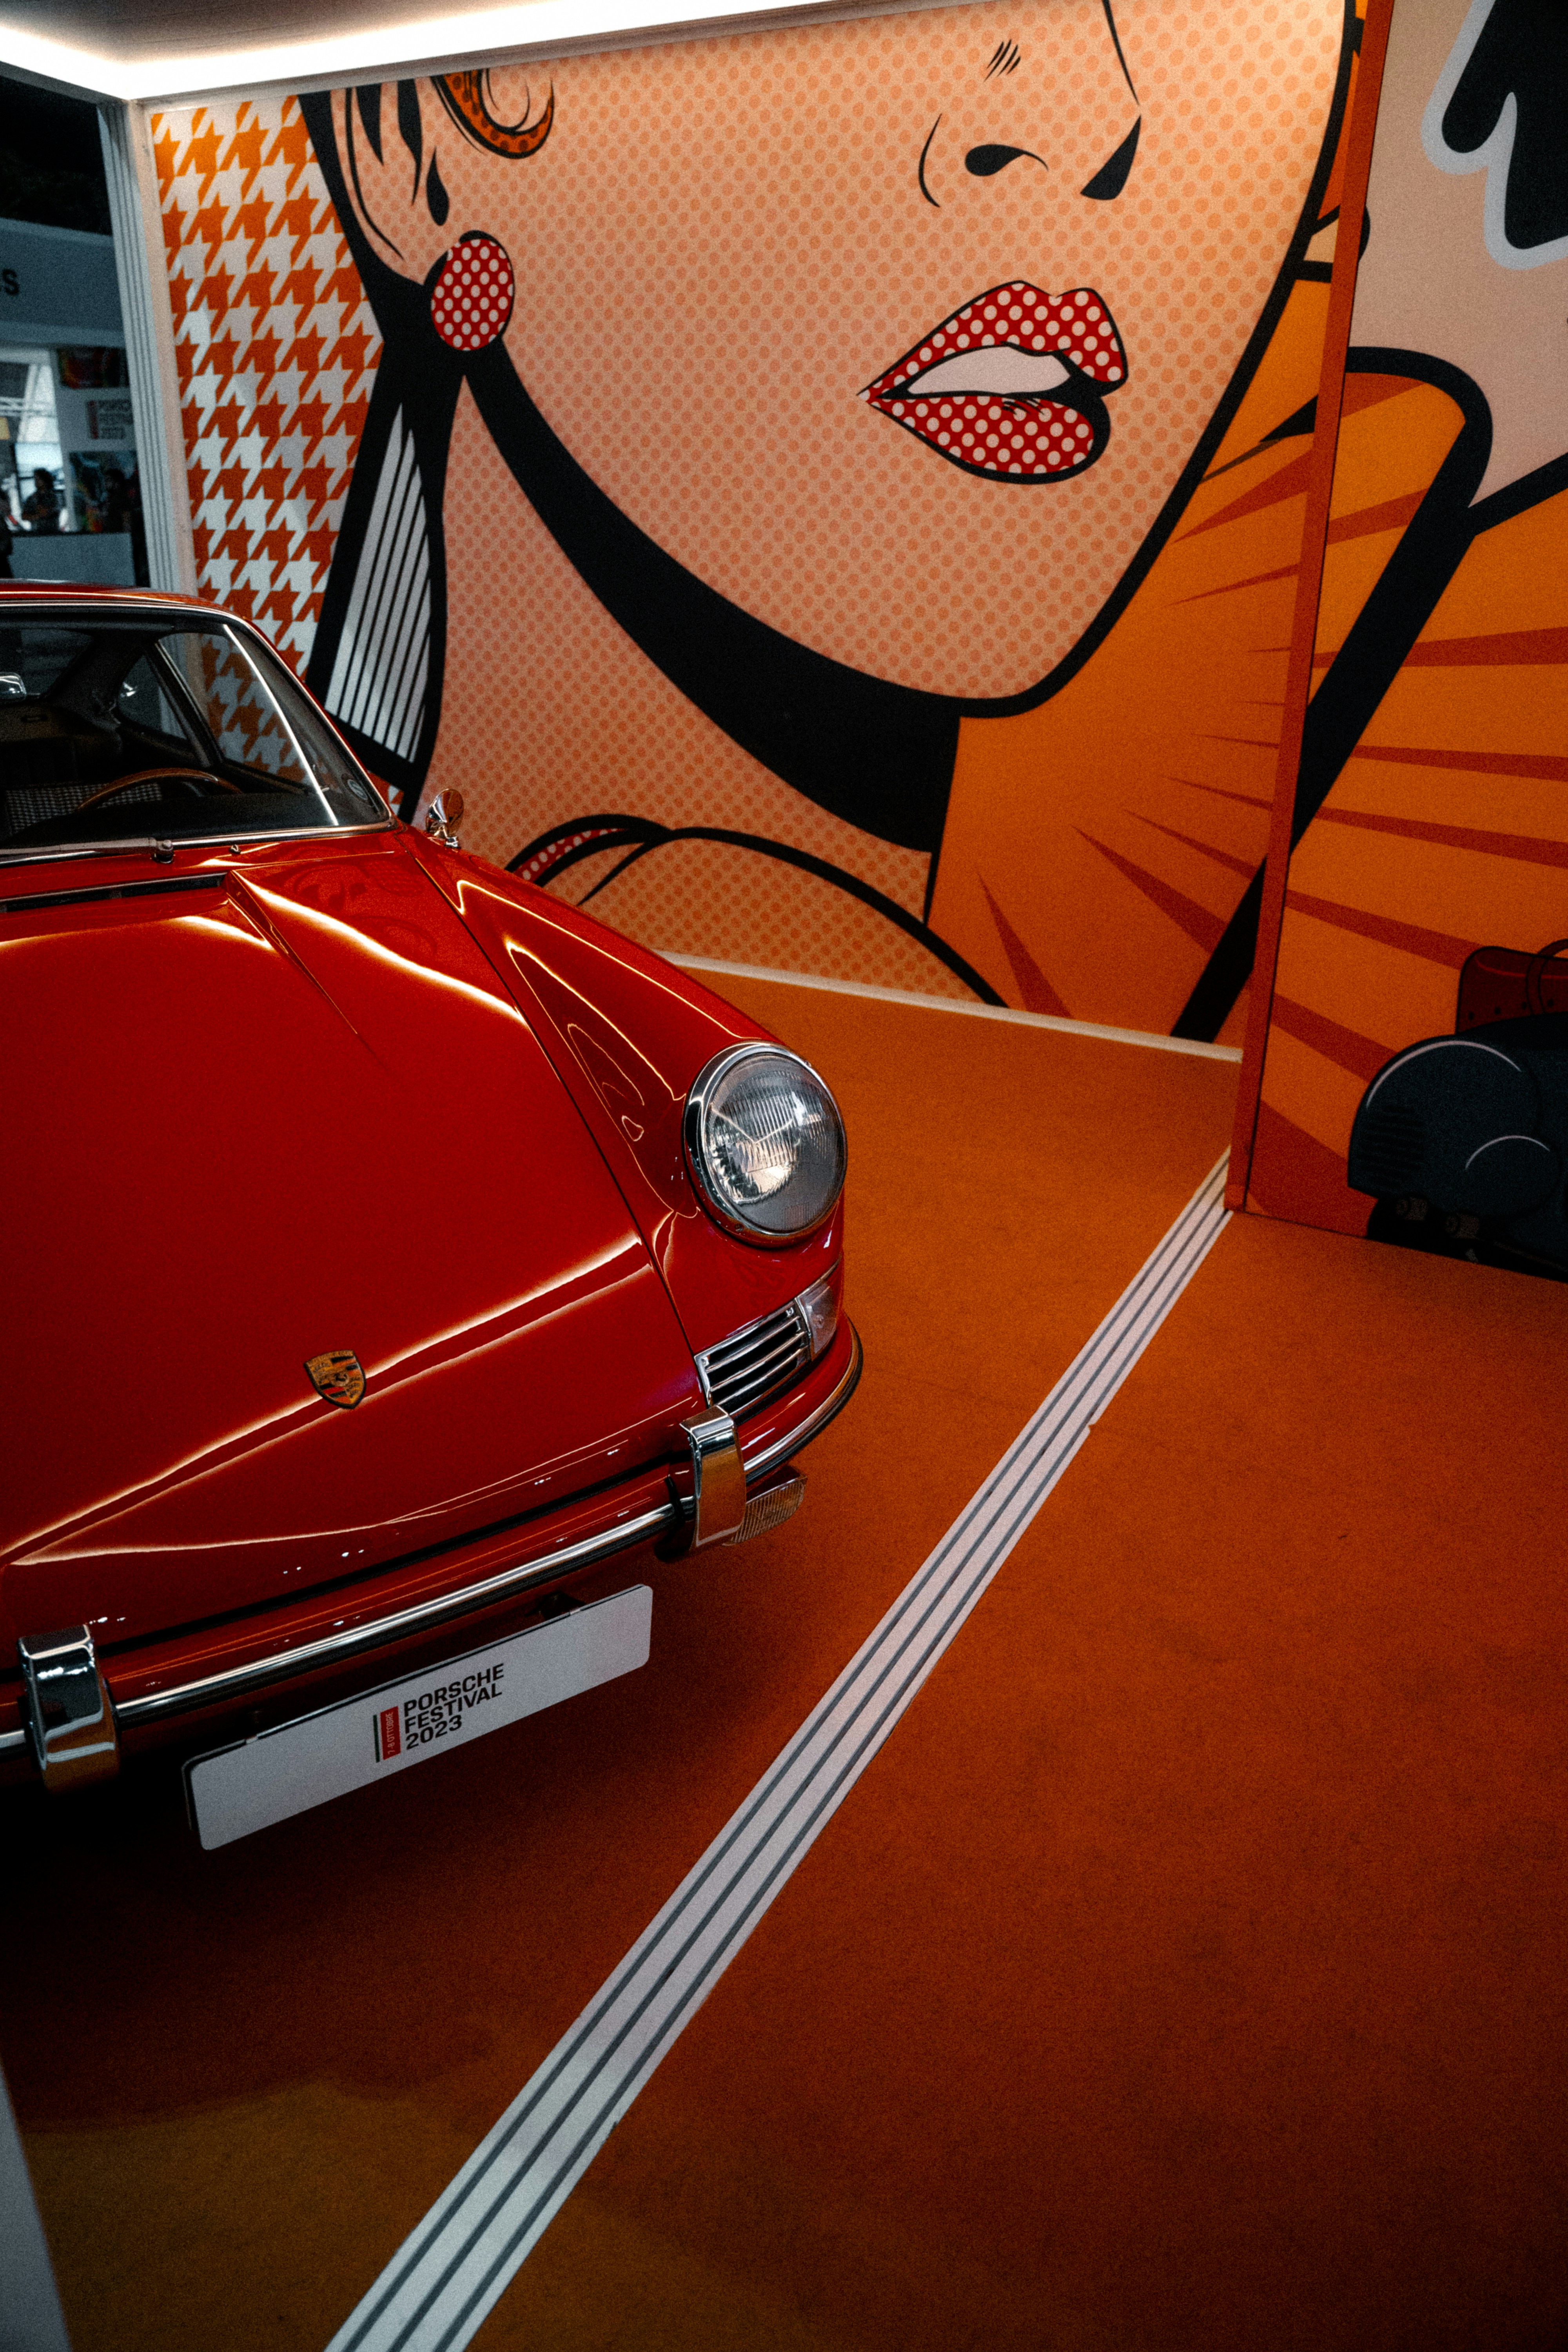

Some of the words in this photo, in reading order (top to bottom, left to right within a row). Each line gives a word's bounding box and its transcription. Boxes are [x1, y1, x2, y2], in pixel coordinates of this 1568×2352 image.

[0, 268, 19, 296] S
[404, 1663, 504, 1717] PORSCHE
[405, 1683, 503, 1734] FESTIVAL
[385, 1712, 395, 1742] OTTOBRE
[405, 1715, 462, 1750] 2023
